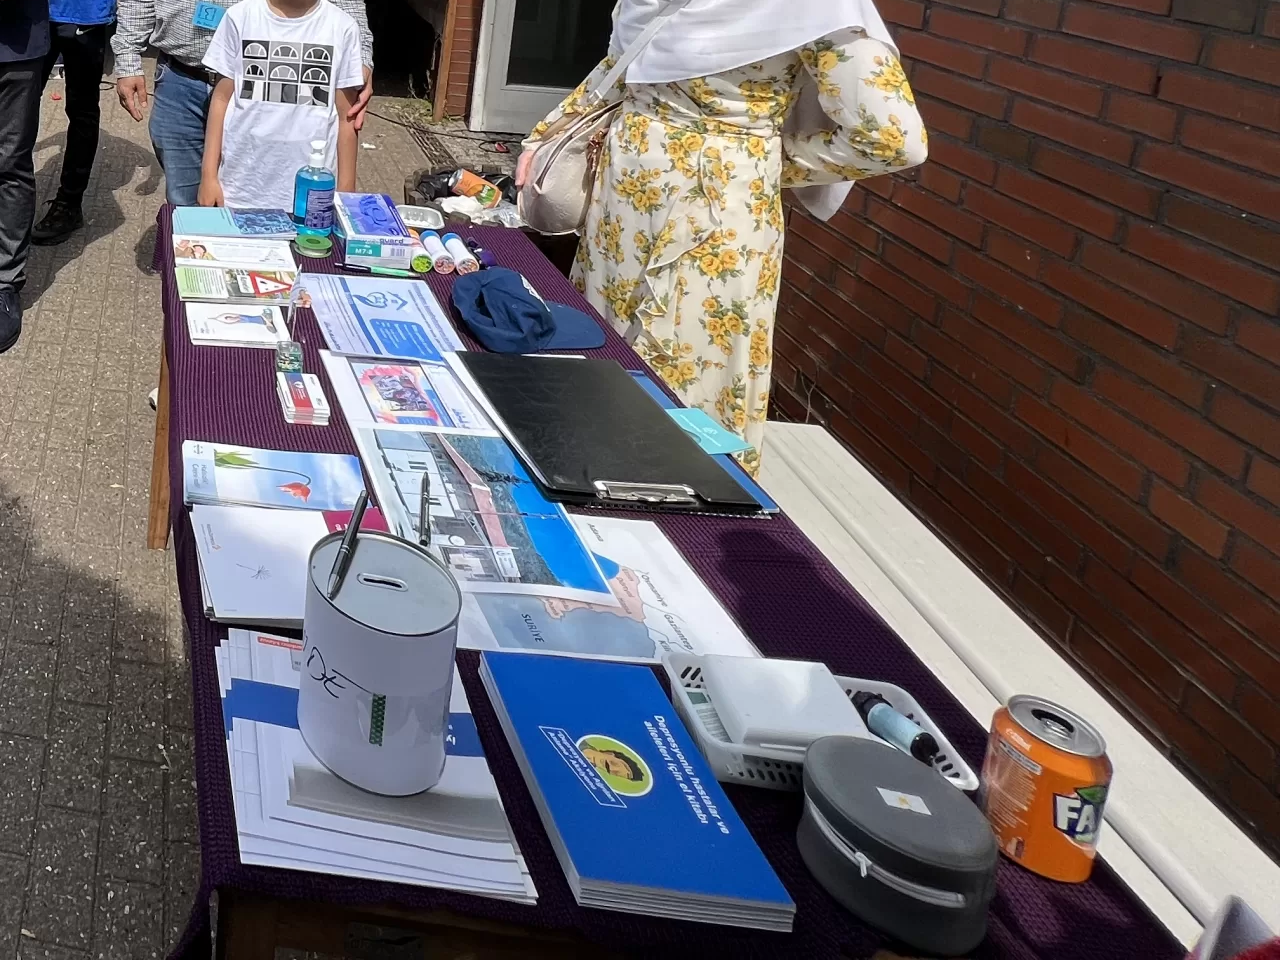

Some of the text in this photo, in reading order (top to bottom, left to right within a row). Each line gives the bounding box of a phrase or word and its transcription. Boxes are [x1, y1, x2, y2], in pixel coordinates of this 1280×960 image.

[587, 522, 604, 542] Adana
[641, 574, 667, 608] Osmaniye
[658, 639, 670, 652] Kili
[664, 614, 693, 650] Gaziantep
[654, 715, 694, 776] Depresyonlu
[690, 771, 721, 819] hastalar
[716, 820, 730, 835] ve
[667, 758, 684, 782] için
[679, 780, 691, 796] el
[685, 791, 709, 825] kitabı
